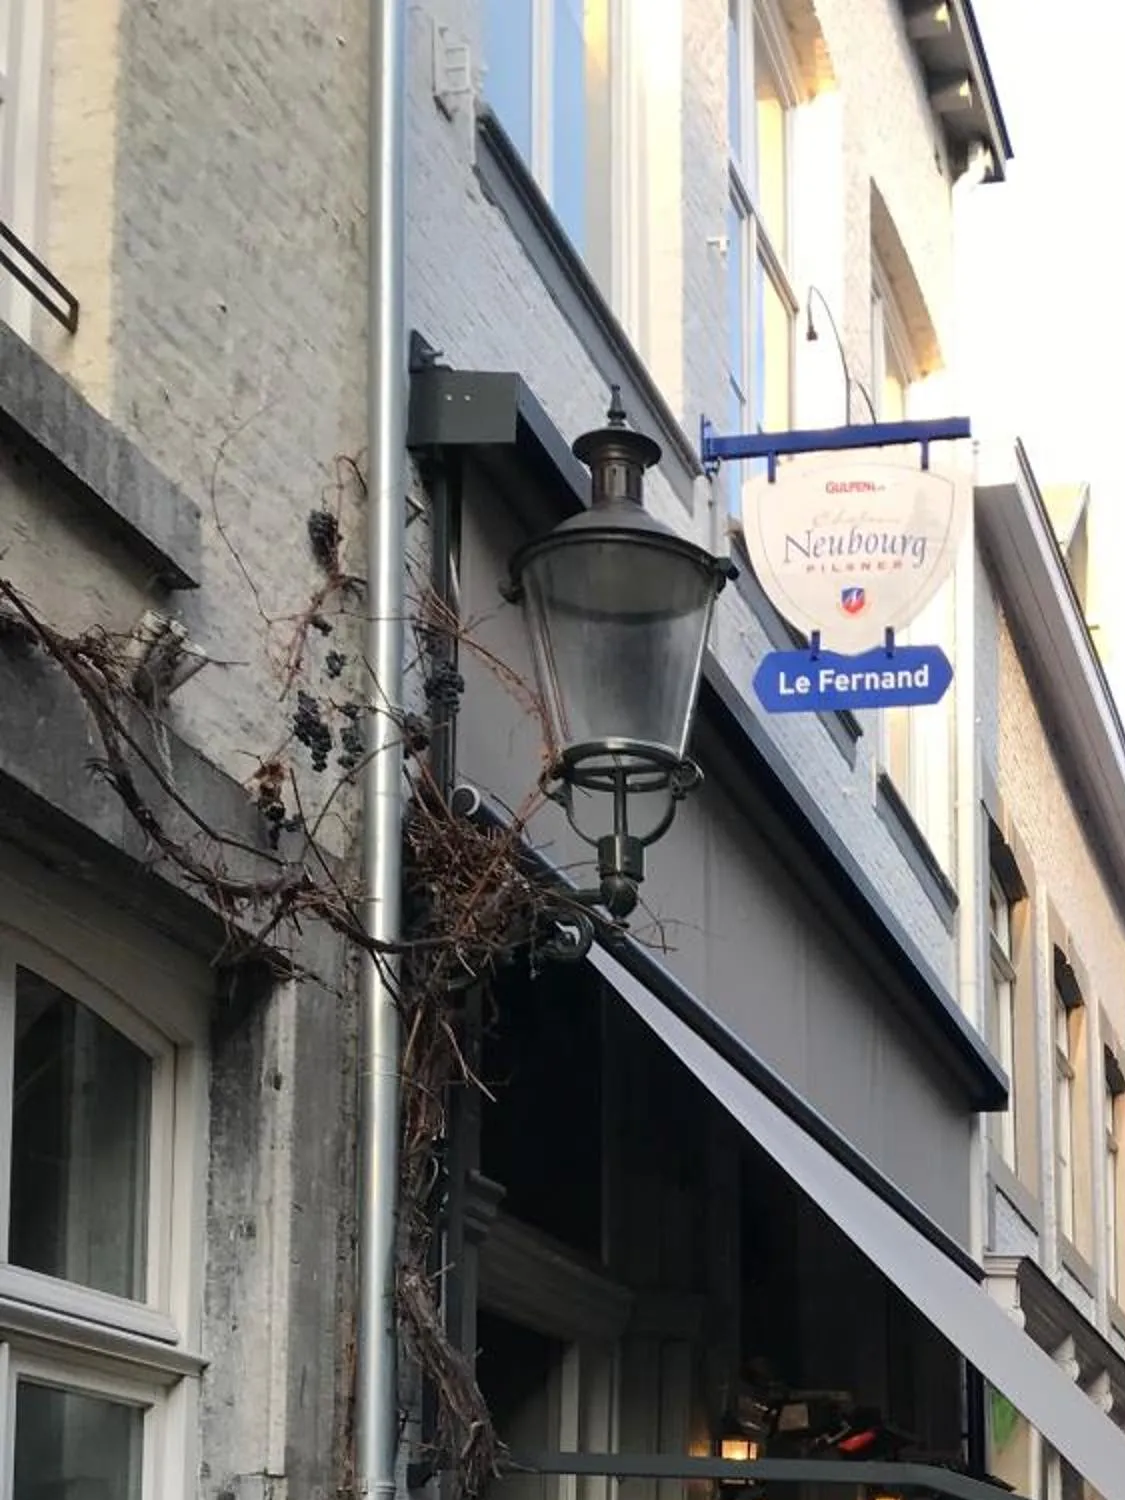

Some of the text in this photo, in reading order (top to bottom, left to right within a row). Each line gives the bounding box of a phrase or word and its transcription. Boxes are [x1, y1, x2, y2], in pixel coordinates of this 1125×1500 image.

[784, 525, 928, 570] Neubourg
[805, 560, 904, 574] PILSNER
[778, 671, 811, 695] Le
[818, 663, 930, 693] Fernand
